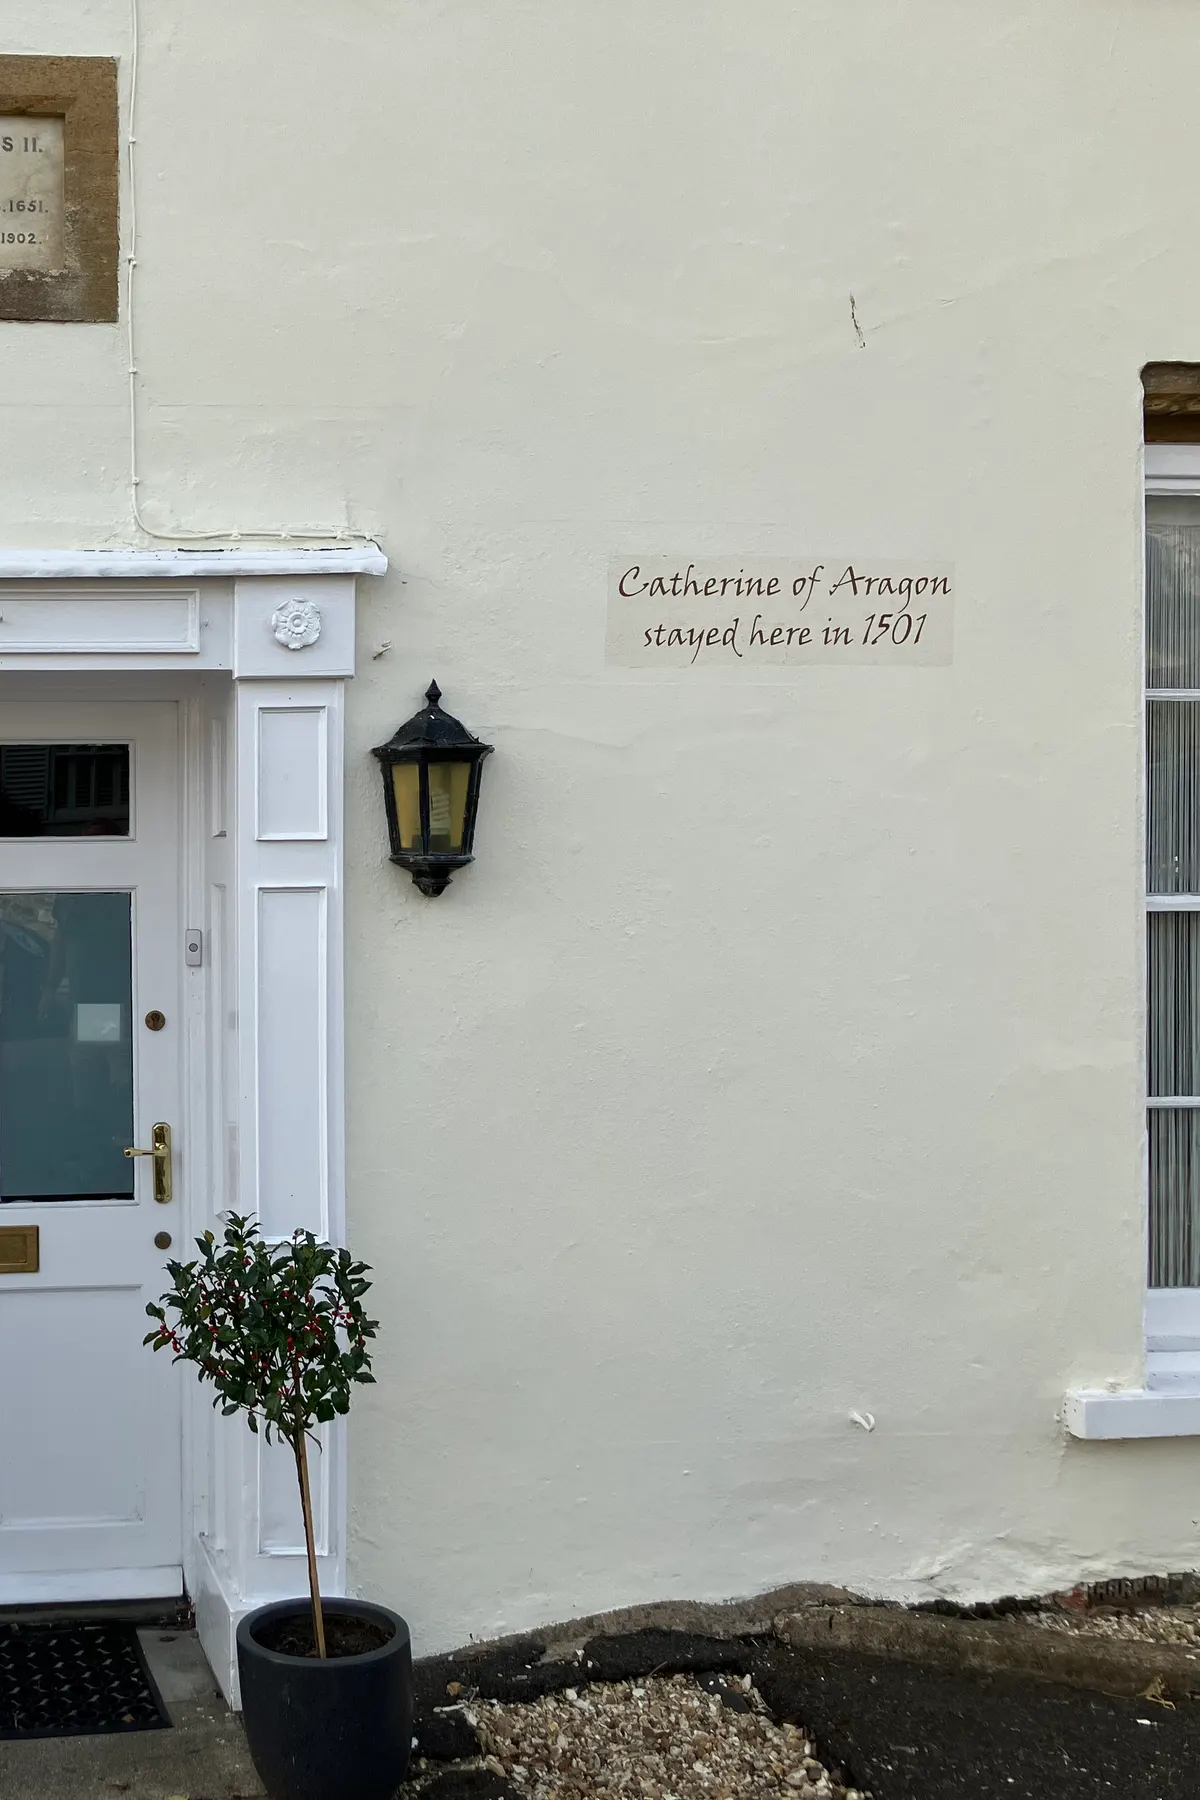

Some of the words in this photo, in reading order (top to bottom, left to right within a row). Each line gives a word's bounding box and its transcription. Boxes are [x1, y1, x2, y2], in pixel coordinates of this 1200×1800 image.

[618, 564, 782, 598] Catherine
[792, 564, 825, 612] of
[828, 565, 952, 613] Aragon
[643, 618, 743, 664] stayed
[749, 614, 813, 647] here
[821, 617, 854, 646] in
[862, 613, 928, 646] 1501
